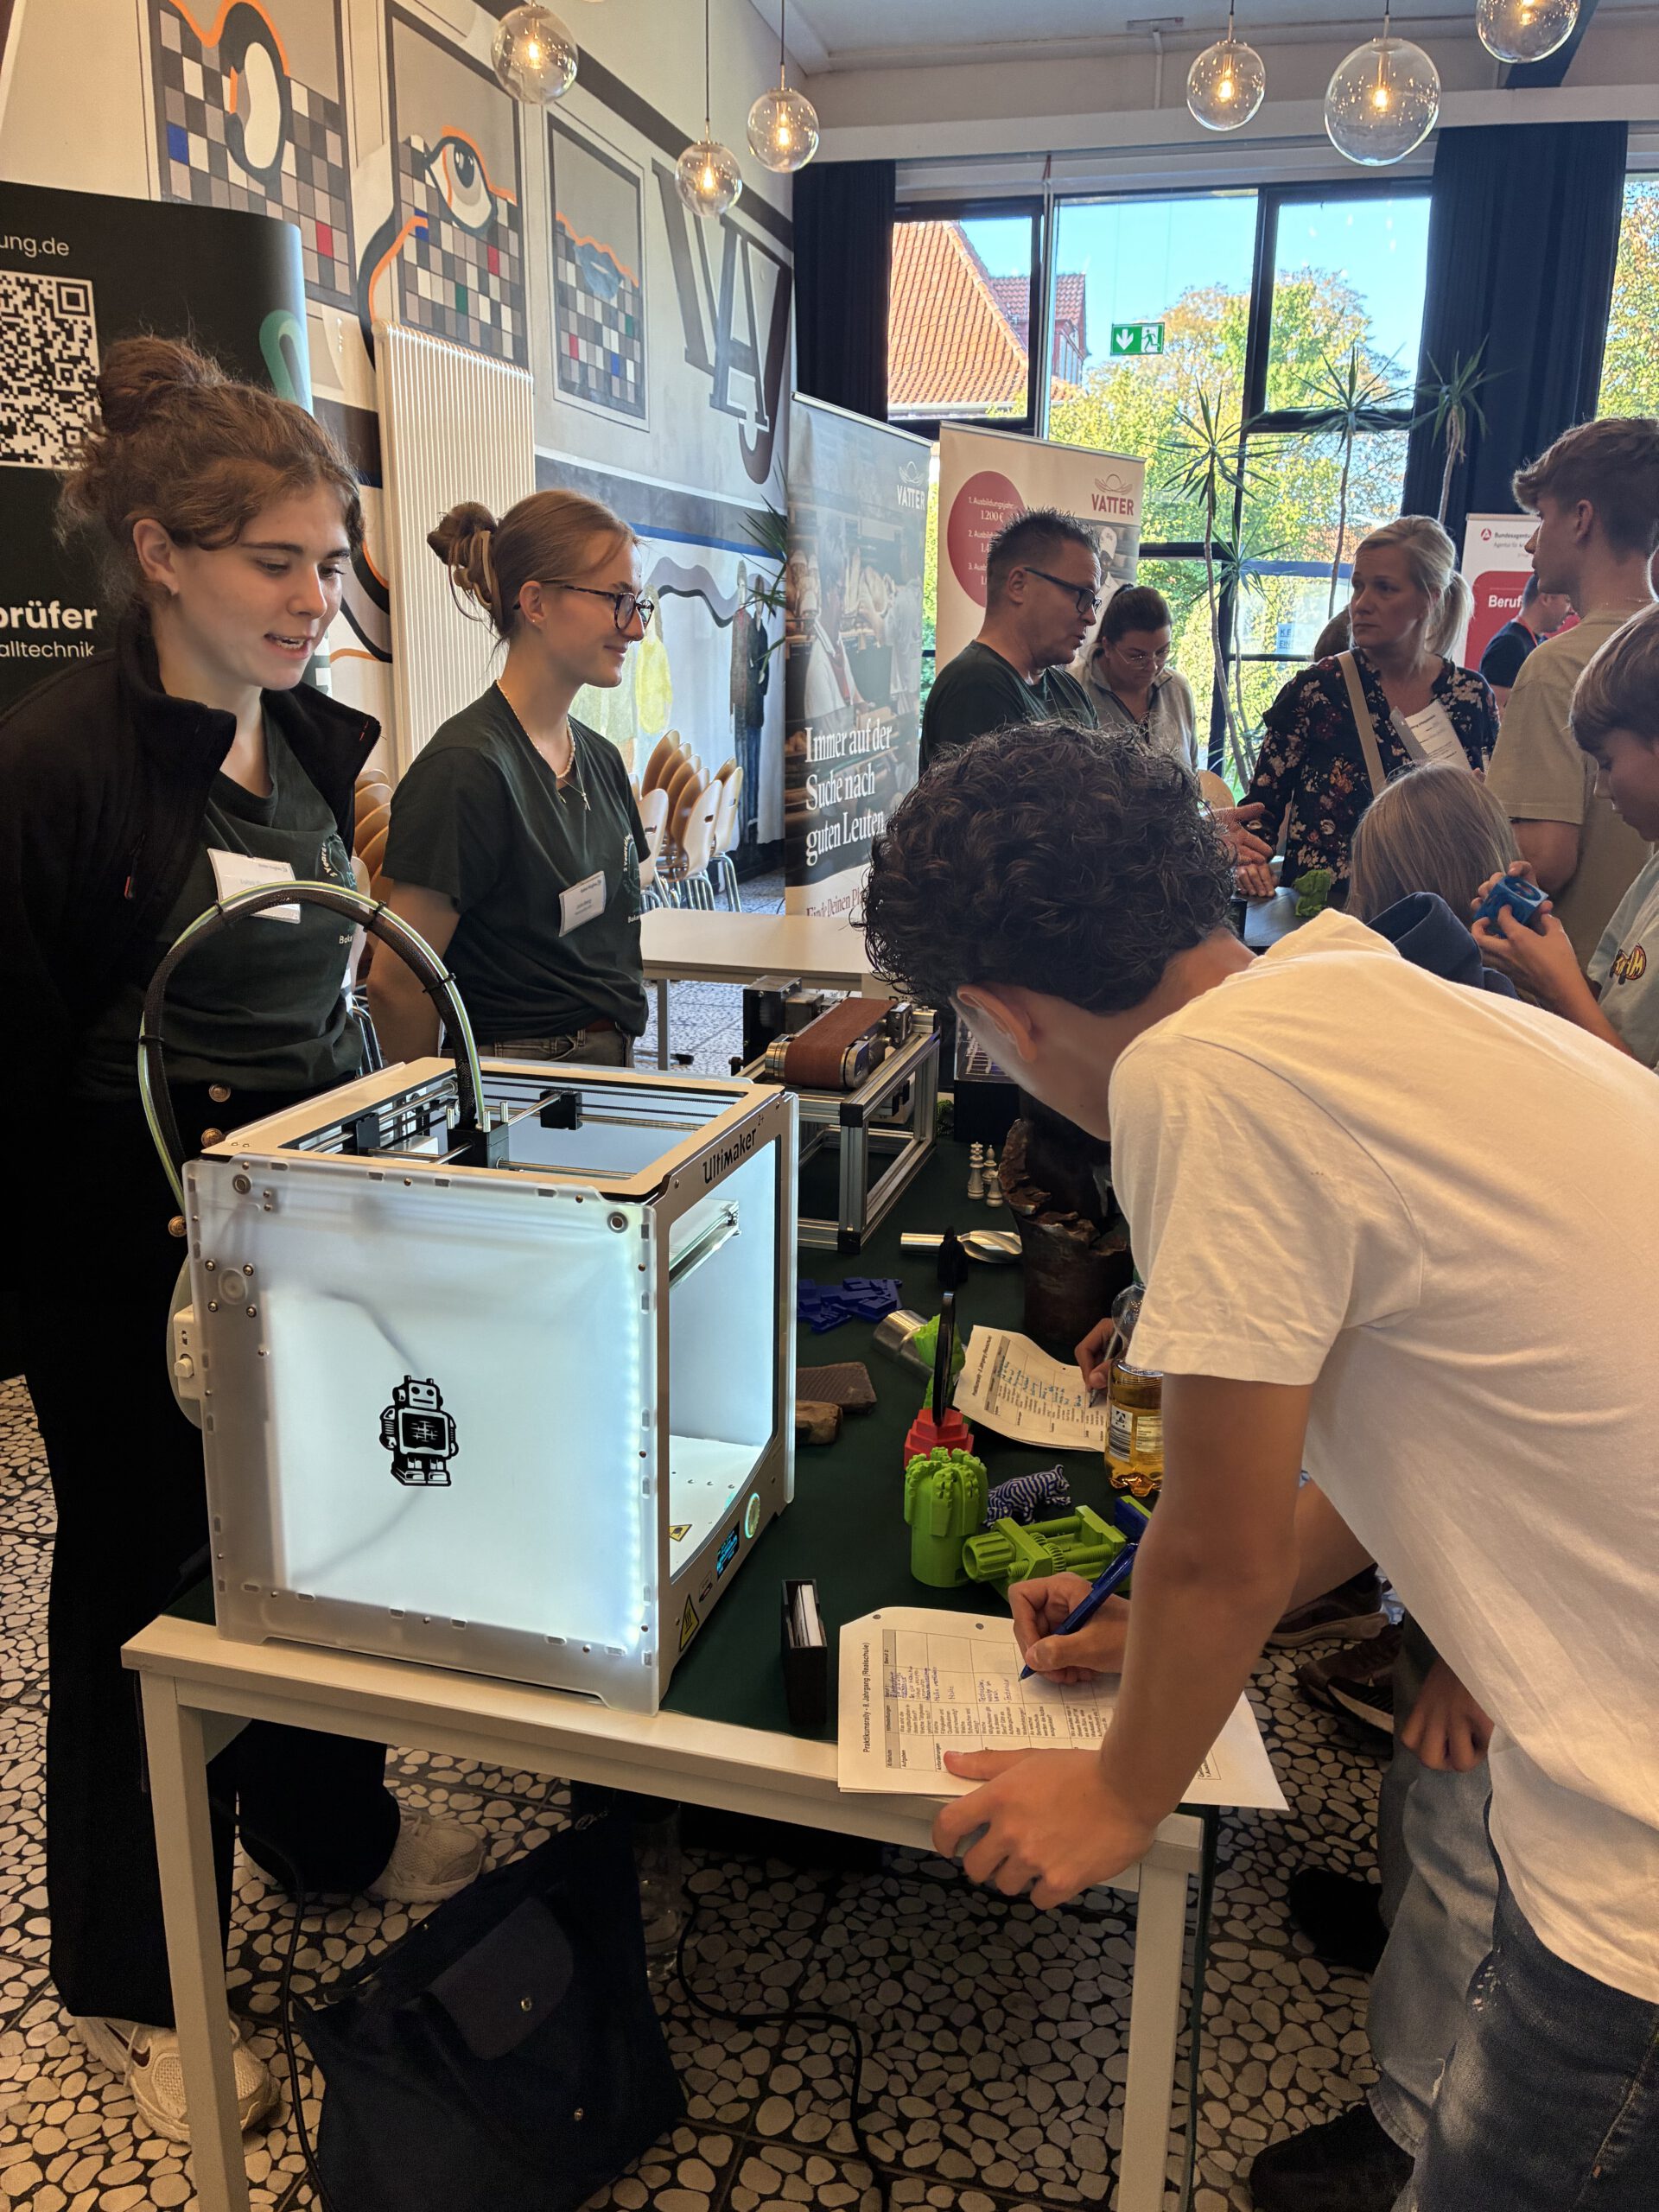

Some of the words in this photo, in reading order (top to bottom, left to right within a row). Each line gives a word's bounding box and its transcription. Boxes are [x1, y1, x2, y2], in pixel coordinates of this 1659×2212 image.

[0, 235, 70, 258] ung.de
[897, 485, 925, 511] VATTER
[1091, 493, 1135, 517] VATTER
[1495, 531, 1532, 542] Bundesagentu
[804, 728, 848, 763] Immer
[849, 719, 872, 756] auf
[872, 717, 893, 751] der
[805, 769, 843, 811] Suche
[845, 762, 875, 801] nach
[805, 817, 841, 867] guten
[827, 894, 850, 917] Deinen
[702, 1128, 757, 1185] Ultimaker
